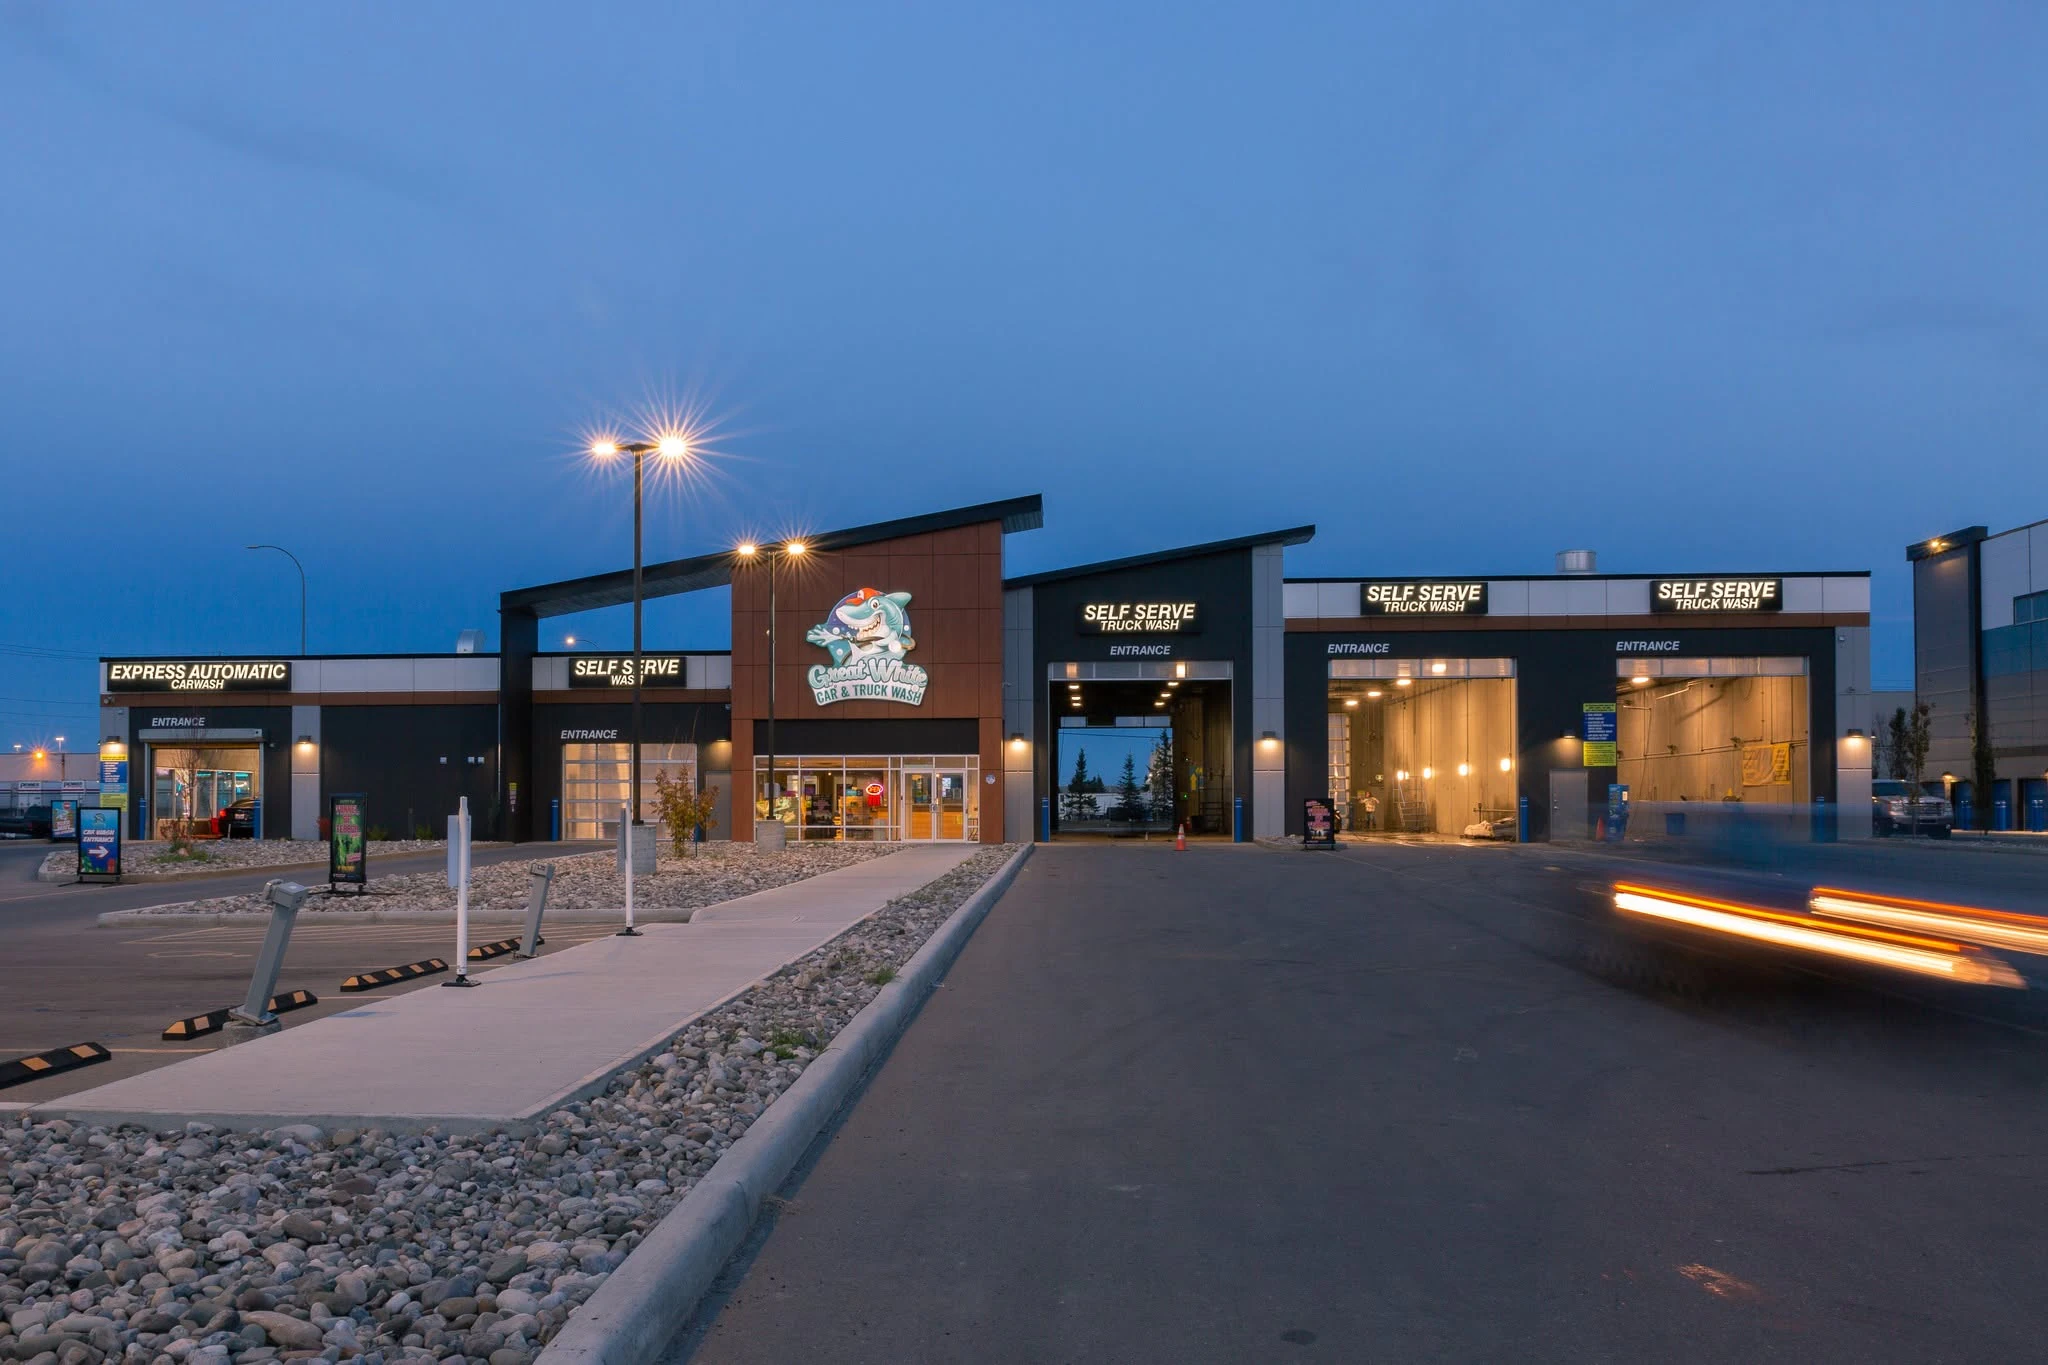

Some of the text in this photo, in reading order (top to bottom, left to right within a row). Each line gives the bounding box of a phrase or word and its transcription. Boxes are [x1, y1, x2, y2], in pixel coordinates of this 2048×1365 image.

[1367, 584, 1482, 602] SELF SERVE
[1658, 582, 1776, 599] SELF SERVE
[1383, 601, 1465, 613] TRUCK WASH
[1675, 598, 1759, 610] TRUCK WASH
[1084, 603, 1196, 620] SELF SERVE
[1100, 620, 1180, 631] TRUCK WASH
[1110, 645, 1171, 656] ENTRANCE
[1327, 643, 1390, 653] ENTRANCE
[1616, 641, 1680, 651] ENTRANCE
[110, 664, 286, 680] EXPRESS AUTOMATIC
[574, 659, 618, 676] SELF
[808, 658, 929, 690] Great White
[171, 679, 225, 690] CARWASH
[611, 675, 644, 686] WAS
[816, 684, 922, 704] CAR & TRUCK WASH
[151, 716, 206, 727] ENTRANCE
[560, 729, 618, 740] ENTRANCE
